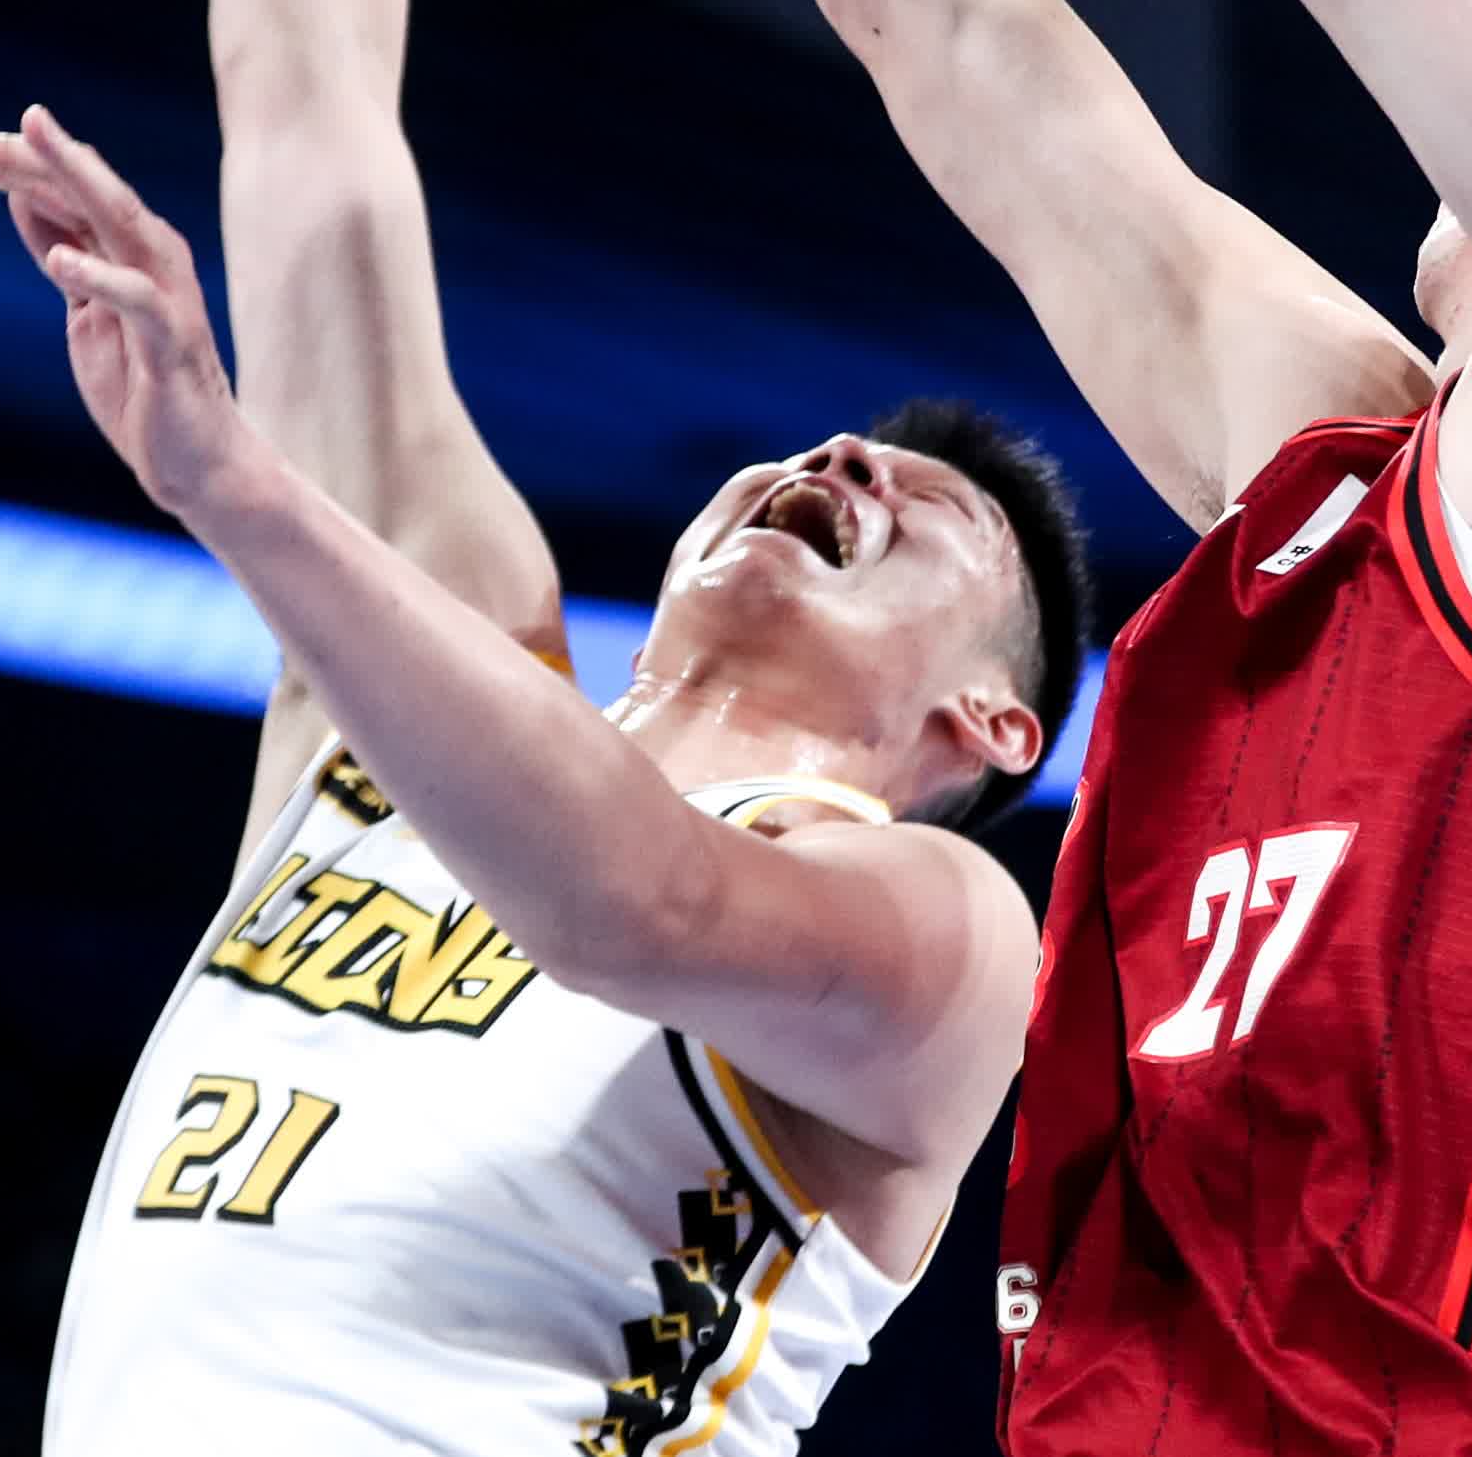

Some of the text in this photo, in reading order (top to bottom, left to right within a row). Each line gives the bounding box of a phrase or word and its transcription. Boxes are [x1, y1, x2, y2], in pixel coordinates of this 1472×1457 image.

[204, 852, 540, 1038] LIONS
[1127, 821, 1359, 1063] 27
[133, 1074, 340, 1225] 21
